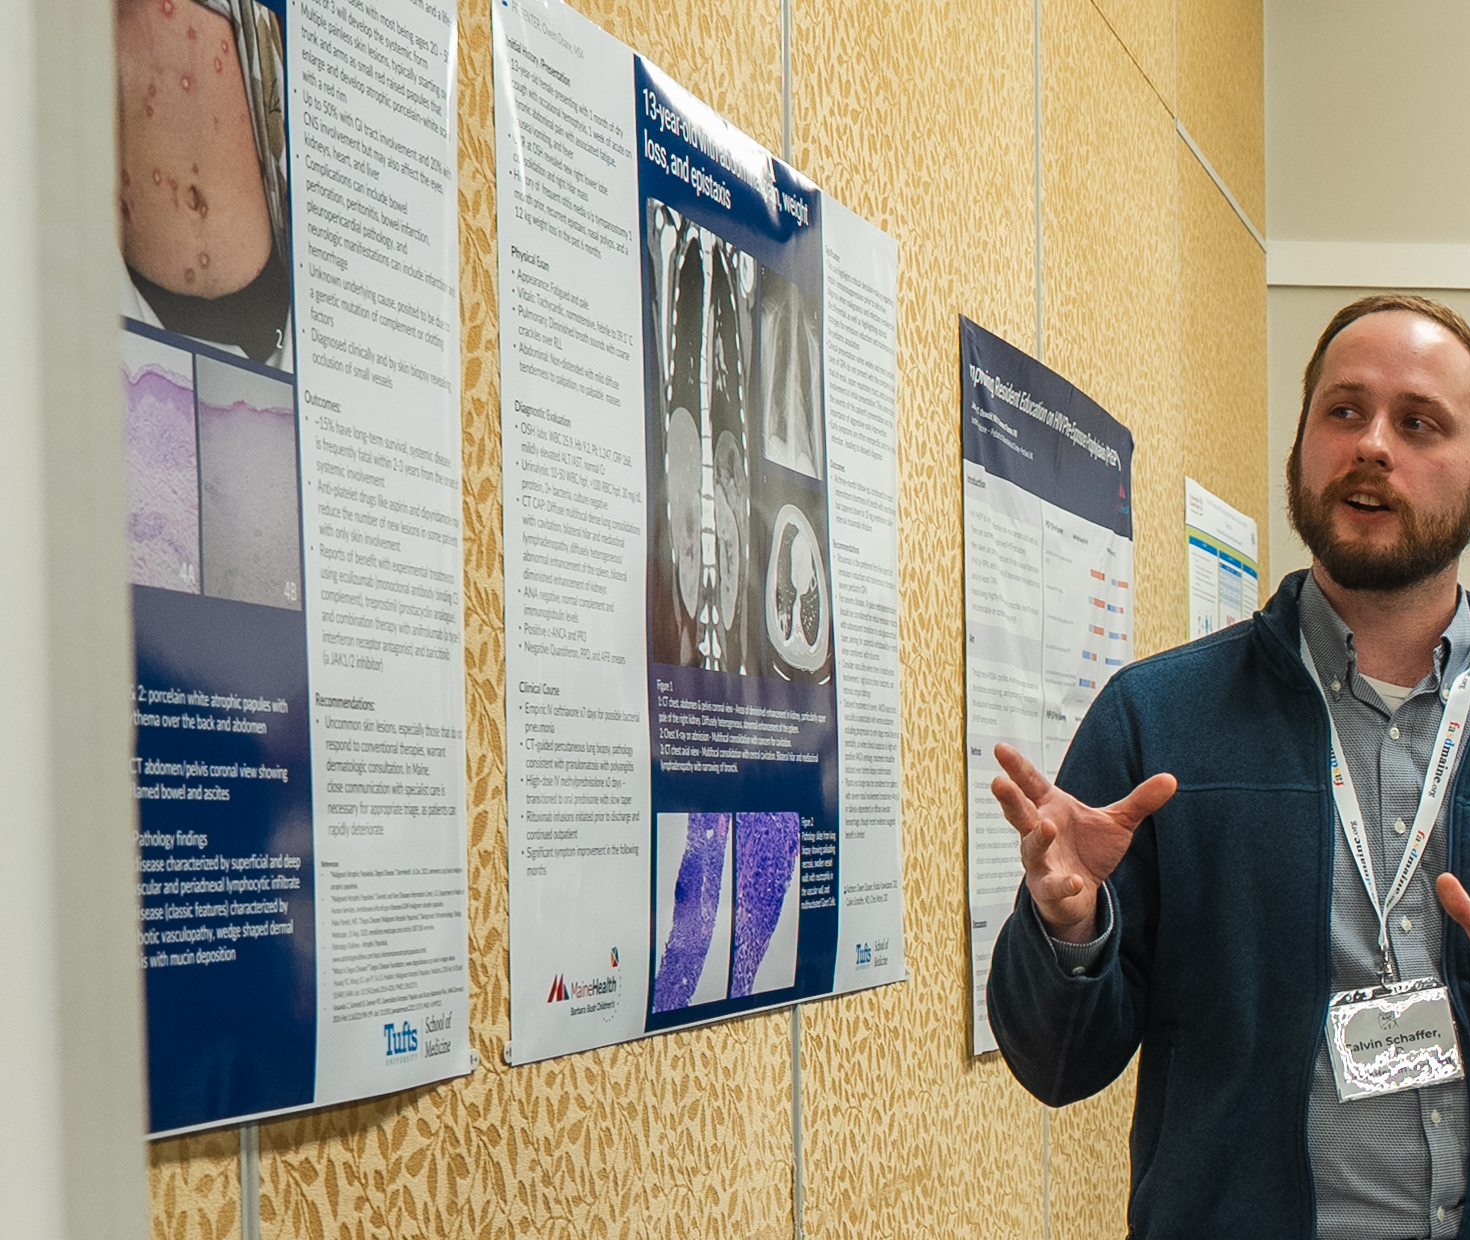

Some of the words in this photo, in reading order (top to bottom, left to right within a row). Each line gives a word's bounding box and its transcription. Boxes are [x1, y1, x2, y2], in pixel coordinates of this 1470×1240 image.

[301, 2, 326, 31] Multiple
[328, 22, 352, 46] painless
[354, 36, 366, 54] skin
[367, 42, 390, 70] lesions,
[391, 58, 416, 87] typically
[418, 75, 438, 100] starting
[301, 25, 317, 47] trunk
[319, 38, 331, 54] and
[333, 46, 348, 64] arms
[349, 55, 356, 68] as
[357, 60, 373, 78] small
[374, 69, 385, 85] red
[386, 76, 405, 96] raised
[406, 87, 429, 109] papules
[430, 99, 441, 116] that
[304, 131, 331, 160] kidneys,
[332, 145, 352, 170] heart,
[353, 160, 365, 175] and
[366, 162, 379, 182] liver
[644, 128, 669, 174] loss,
[671, 154, 690, 183] and
[691, 166, 731, 210] epistaxis
[305, 153, 351, 189] Complications
[353, 180, 364, 195] can
[365, 182, 387, 206] include
[388, 193, 406, 215] bowel
[306, 179, 345, 208] perforation,
[346, 198, 379, 224] peritonitis,
[380, 210, 399, 232] bowel
[400, 219, 429, 247] infarction,
[782, 191, 809, 226] weight
[307, 199, 361, 235] pleuropericardial
[396, 241, 406, 255] and
[308, 240, 348, 272] hemorrhage
[511, 244, 535, 267] Physical
[536, 256, 549, 274] Exam
[310, 305, 333, 328] factors
[276, 329, 283, 349] 2
[304, 389, 341, 414] Outcomes:
[514, 399, 545, 421] Diagnostic
[546, 410, 570, 429] Evaluation
[995, 376, 1021, 408] Resident
[1019, 392, 1048, 423] Education
[1046, 411, 1054, 427] on
[1052, 411, 1063, 432] HIV
[180, 563, 196, 584] 4A
[284, 582, 297, 600] 4B
[148, 687, 186, 707] porcelain
[187, 690, 209, 708] white
[210, 694, 241, 713] atrophic
[241, 697, 270, 715] papules
[272, 699, 288, 715] with
[519, 681, 541, 694] Clinical
[542, 683, 559, 696] Course
[315, 692, 374, 712] Recommendations:
[161, 717, 179, 730] over
[181, 714, 195, 731] the
[196, 715, 215, 732] back
[216, 717, 231, 733] and
[232, 718, 266, 736] abdomen
[144, 759, 208, 782] abdomen/pelvis
[209, 763, 238, 779] coronal
[239, 764, 257, 779] view
[258, 765, 288, 784] showing
[1428, 721, 1460, 798] fasdmaine.org
[160, 785, 186, 802] bowel
[187, 786, 202, 802] and
[203, 786, 229, 802] ascites
[176, 831, 207, 851] findings
[165, 856, 219, 874] characterized
[219, 856, 229, 875] by
[231, 854, 268, 874] superficial
[268, 854, 283, 869] and
[283, 854, 301, 871] deep
[163, 880, 179, 898] and
[180, 878, 225, 901] periadnexal
[225, 876, 269, 897] lymphocytic
[271, 875, 299, 891] infiltrate
[164, 904, 192, 926] (classic
[194, 901, 229, 921] features)
[229, 899, 278, 917] characterized
[278, 898, 288, 917] by
[161, 926, 214, 948] vasculopathy,
[216, 924, 240, 943] wedge
[242, 921, 268, 941] shaped
[269, 919, 292, 936] dermal
[149, 952, 168, 972] with
[169, 950, 194, 969] mucin
[195, 946, 235, 969] deposition
[856, 942, 872, 965] Tufts
[571, 976, 617, 999] MaineHealth
[384, 1020, 418, 1056] Tufts
[425, 1012, 444, 1034] School
[445, 1011, 452, 1030] of
[1386, 1029, 1441, 1046] Schaffer,
[425, 1038, 451, 1058] Medicine
